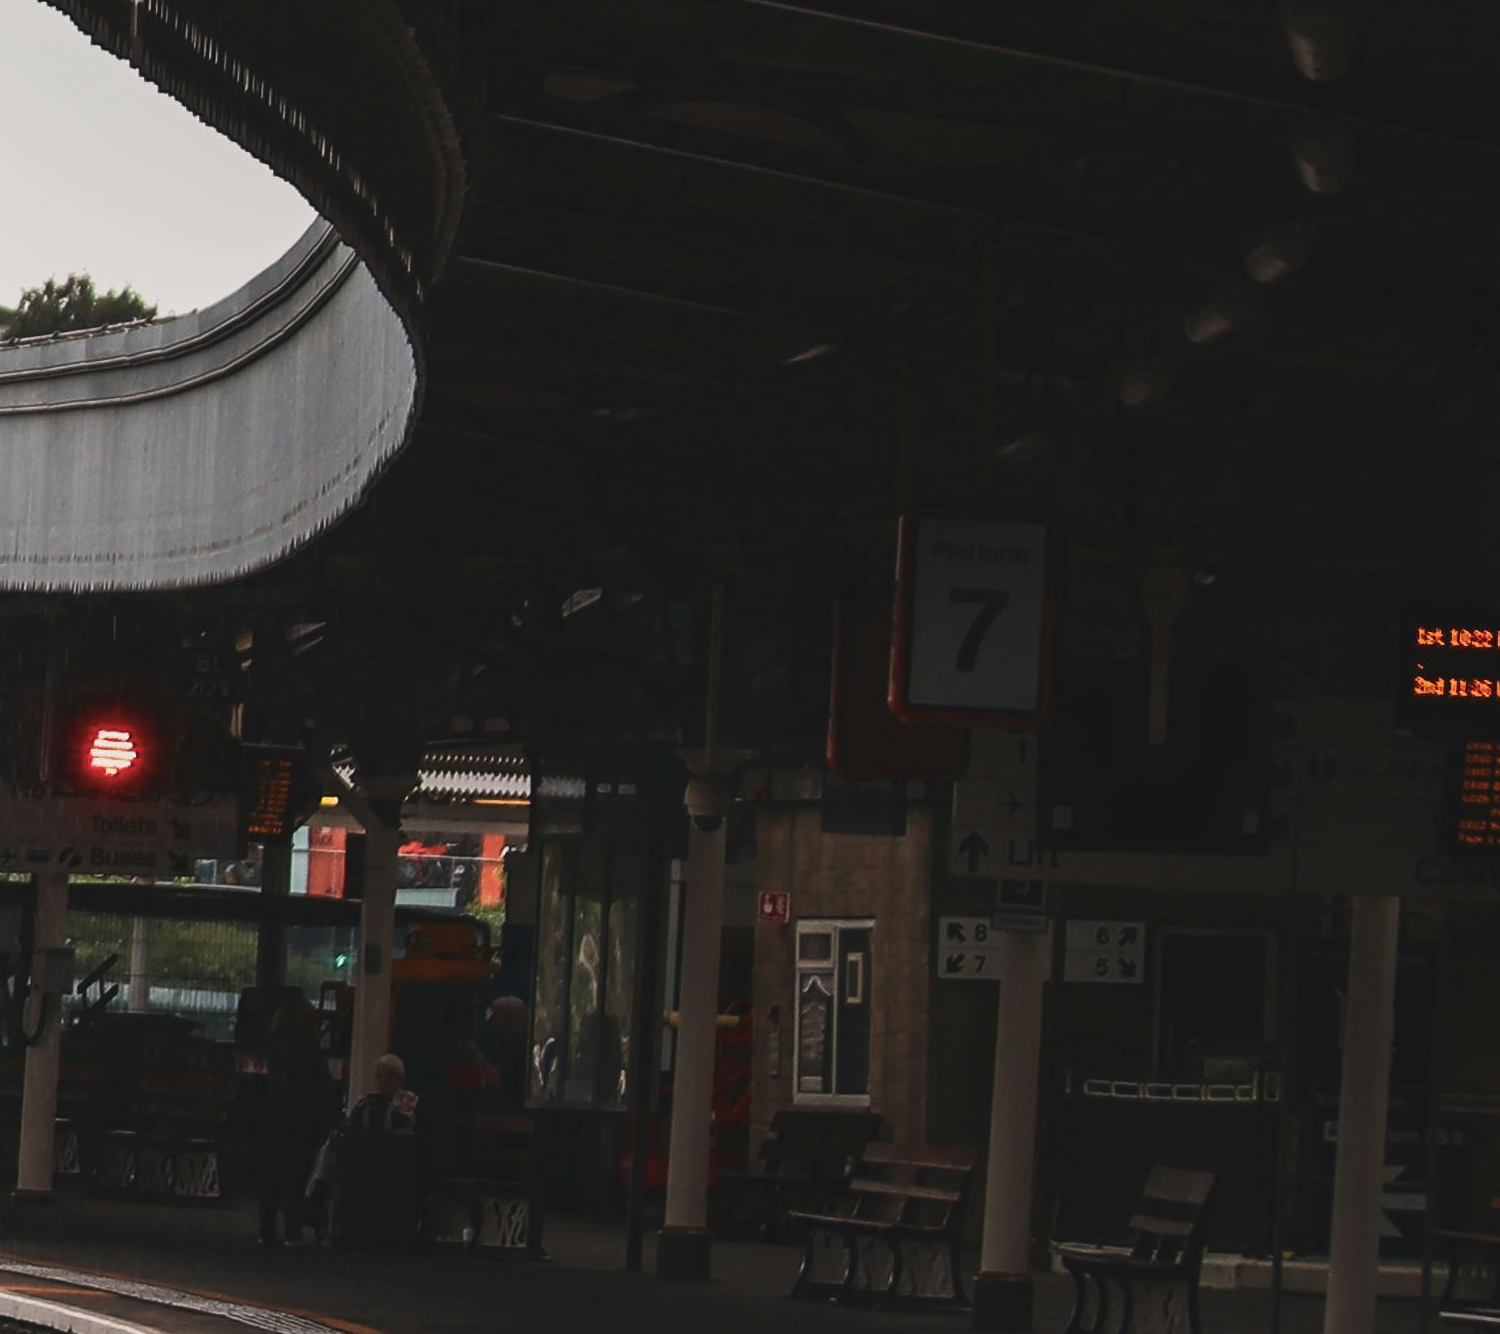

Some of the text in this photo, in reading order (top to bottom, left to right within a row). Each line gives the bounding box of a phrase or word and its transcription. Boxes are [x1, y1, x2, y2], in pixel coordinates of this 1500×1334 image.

[932, 538, 1029, 565] Platform
[948, 586, 1010, 672] 7
[91, 815, 158, 835] Toilets
[92, 847, 158, 868] Buses
[974, 924, 988, 942] 8
[1095, 927, 1110, 945] 6
[973, 955, 987, 973] 7
[1094, 957, 1109, 976] 5
